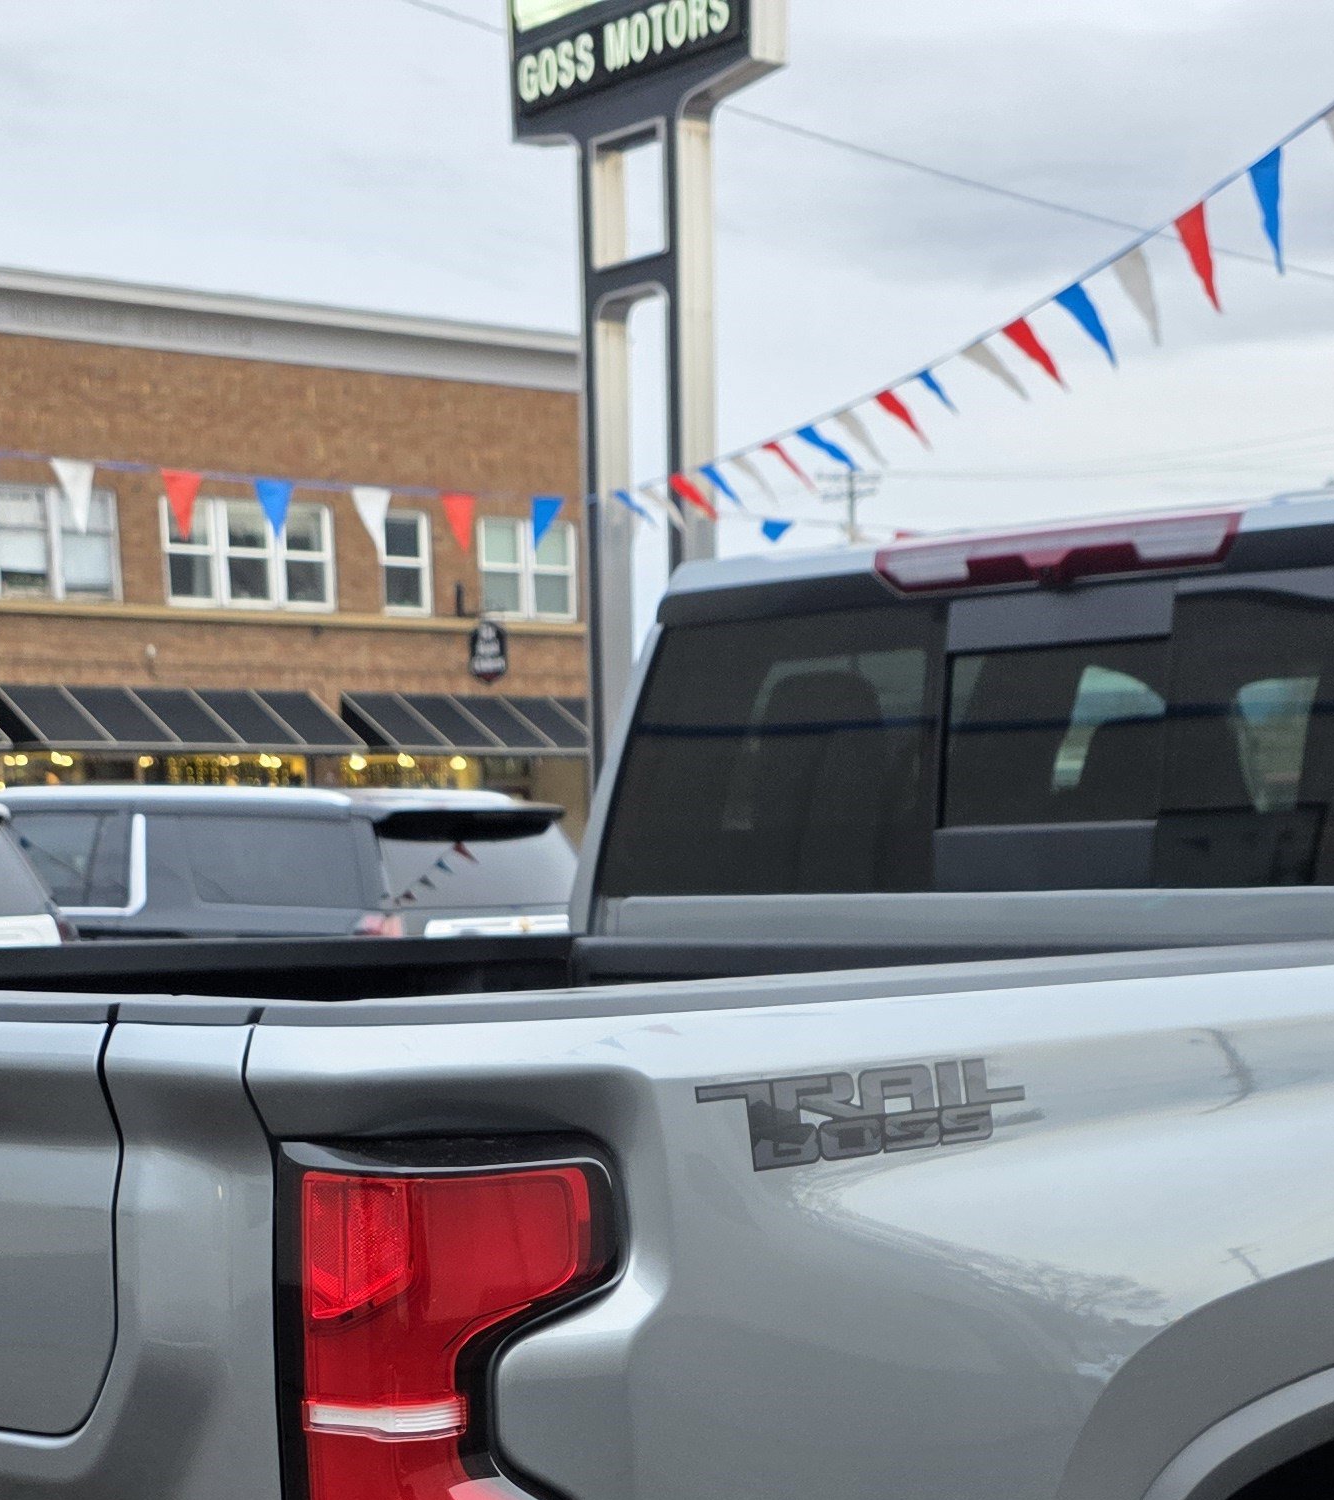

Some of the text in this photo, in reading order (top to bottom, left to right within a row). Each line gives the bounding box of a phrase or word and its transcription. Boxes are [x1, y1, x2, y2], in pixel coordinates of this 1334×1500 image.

[519, 0, 730, 103] GOSS MOTORS
[695, 1058, 1025, 1132] TRAIL
[750, 1103, 994, 1172] BOSS
